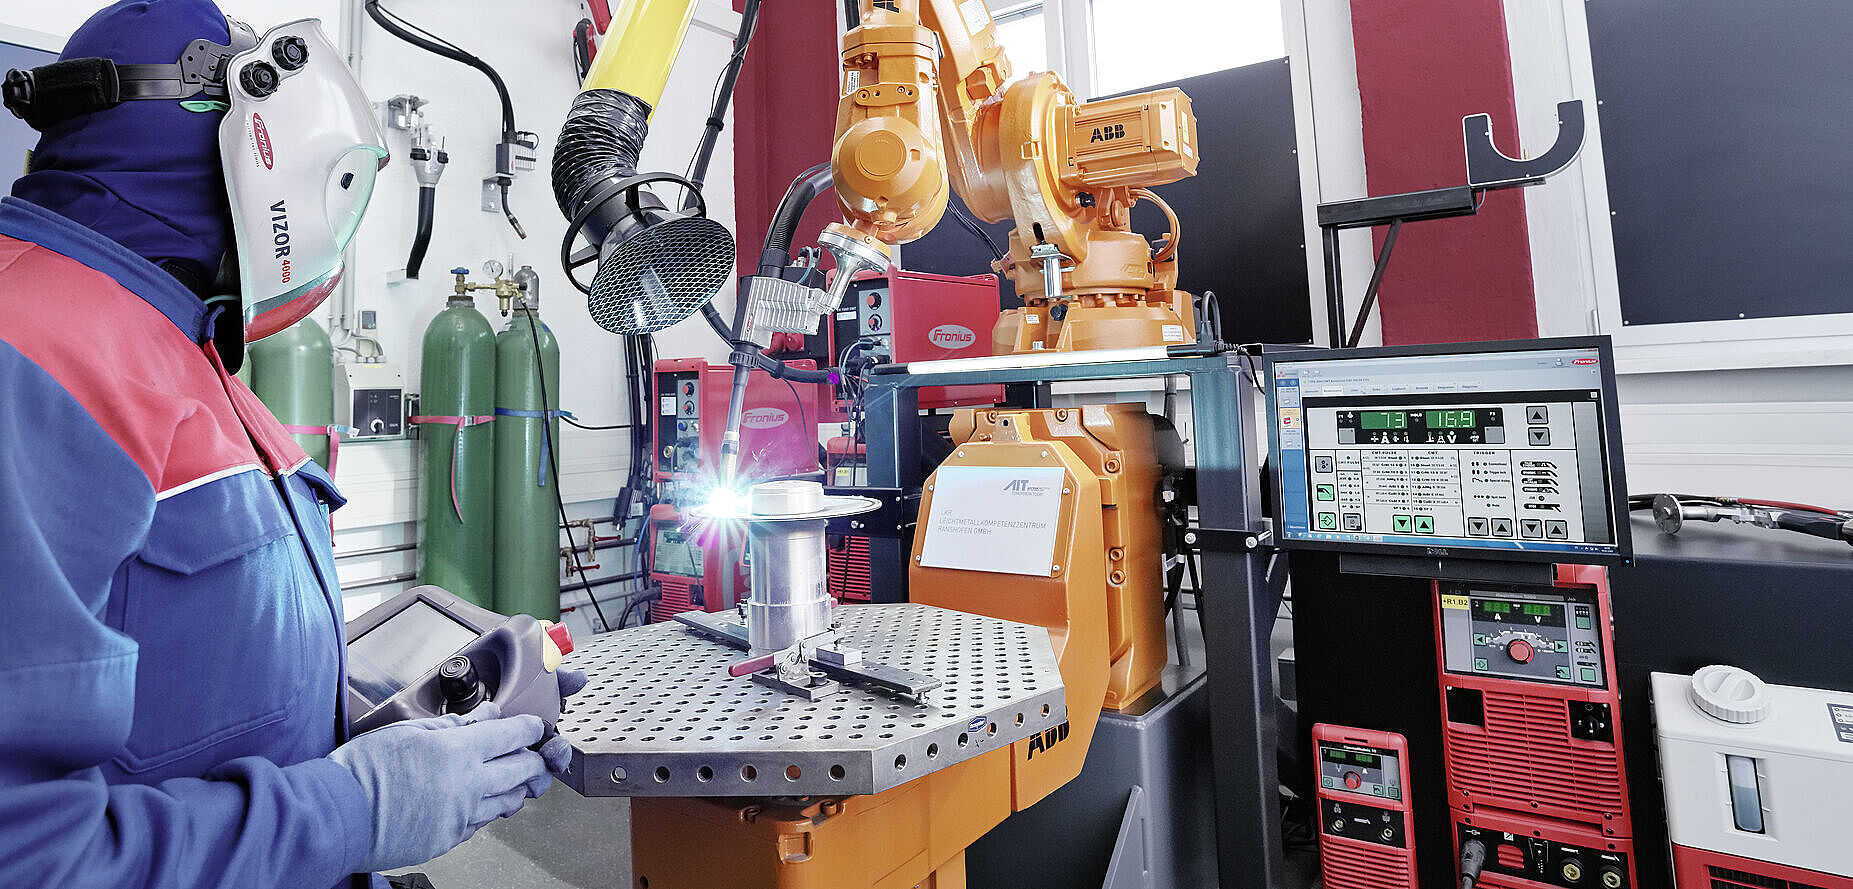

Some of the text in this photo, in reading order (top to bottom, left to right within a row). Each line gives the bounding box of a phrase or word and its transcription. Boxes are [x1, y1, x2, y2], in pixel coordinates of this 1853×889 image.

[1090, 124, 1126, 143] ABB
[254, 115, 273, 168] Fronius
[270, 199, 291, 283] VIZOR 4000
[933, 328, 972, 342] Fronius
[742, 411, 785, 424] Fronius
[1380, 412, 1405, 428] 73
[1438, 411, 1473, 428] 16.9
[1002, 479, 1029, 492] AIT
[938, 526, 972, 534] RANSHOFEN
[939, 516, 1047, 529] LEICHTMETALLKOMPETENZZENTRUM
